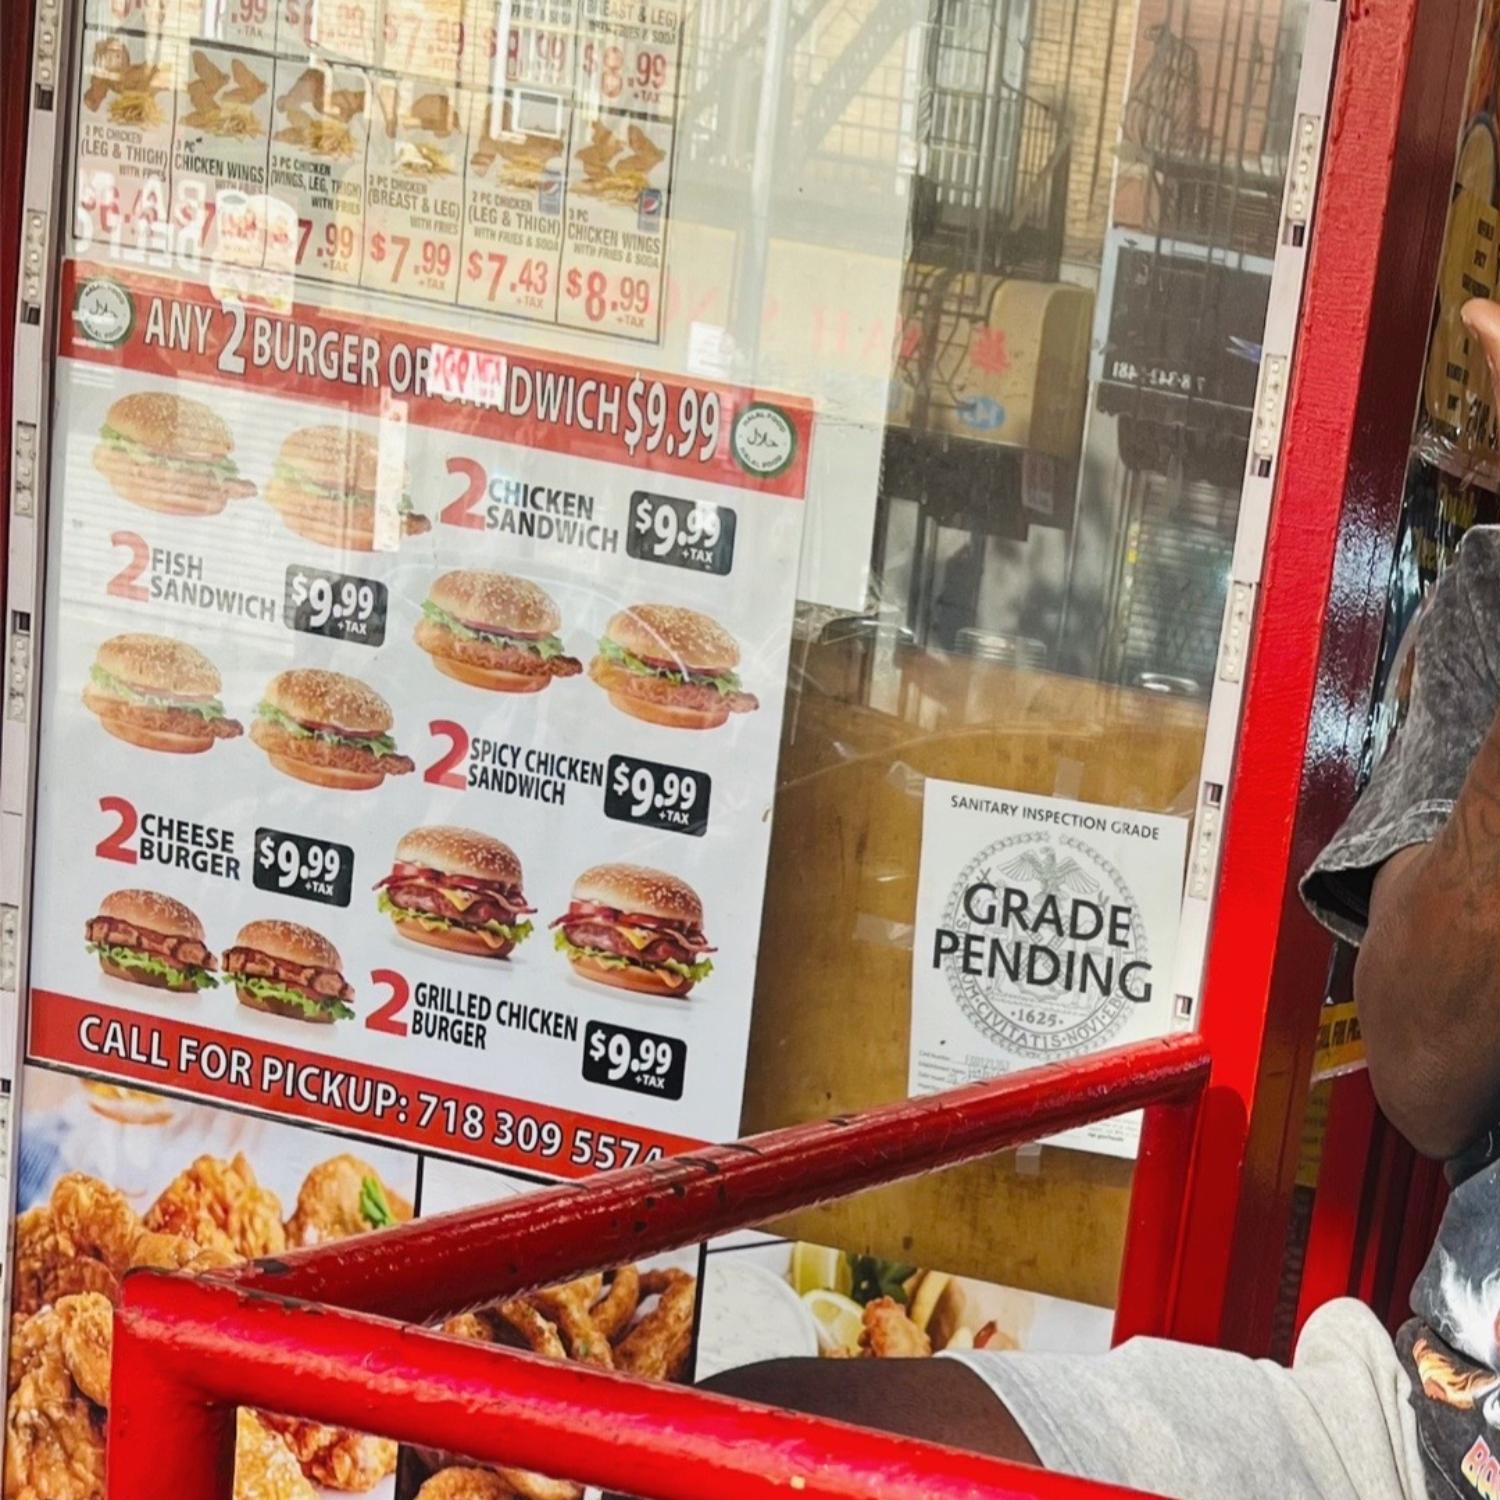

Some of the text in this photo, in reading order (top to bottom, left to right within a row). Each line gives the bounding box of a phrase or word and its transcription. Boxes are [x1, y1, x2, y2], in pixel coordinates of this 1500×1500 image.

[174, 155, 265, 185] CHICKEN WINGS
[368, 188, 420, 214] (BREAST
[433, 200, 461, 220] LEG)
[468, 203, 561, 238] (LEG & THIGH)
[370, 231, 452, 283] $7.99
[568, 224, 661, 254] CHICKEN WINGS
[573, 241, 596, 257] WITH
[467, 250, 548, 302] $7.43
[565, 266, 651, 322] $8.99
[144, 297, 213, 355] ANY
[216, 297, 248, 376] 2
[252, 317, 381, 388] BURGER
[387, 342, 431, 398] OR
[624, 372, 721, 463] $9.99
[440, 457, 594, 531] 2 CHICKEN
[486, 506, 618, 554] SANDWICH
[634, 499, 722, 556] $9.99
[106, 530, 203, 603] 2 FISH
[681, 548, 713, 564] +TAX
[150, 576, 277, 623] SANDWICH
[291, 572, 375, 628] $9.99
[337, 619, 368, 636] +TAX
[423, 718, 604, 791] 2 SPICY CHICKEN
[468, 763, 566, 806] SANDWICH
[613, 761, 697, 817] $9.99
[95, 796, 235, 865] 2 CHEESE
[659, 809, 690, 826] +TAX
[950, 793, 1160, 841] SANITARY INSPECTION GRADE
[140, 837, 240, 881] BURGER
[259, 835, 341, 889] $9.99
[305, 880, 335, 897] +TAX
[962, 882, 1132, 949] GRADE
[932, 928, 1153, 1003] PENDING
[365, 968, 579, 1042] 2 GRILLED CHICKEN
[411, 1009, 488, 1051] BURGER
[589, 1029, 673, 1081] $9.99
[79, 1015, 169, 1069] CALL
[179, 1034, 254, 1088] FOR
[261, 1057, 410, 1124] PICKUP:
[417, 1093, 485, 1141] 718
[494, 1112, 562, 1158] 309
[635, 1074, 666, 1090] +TAX
